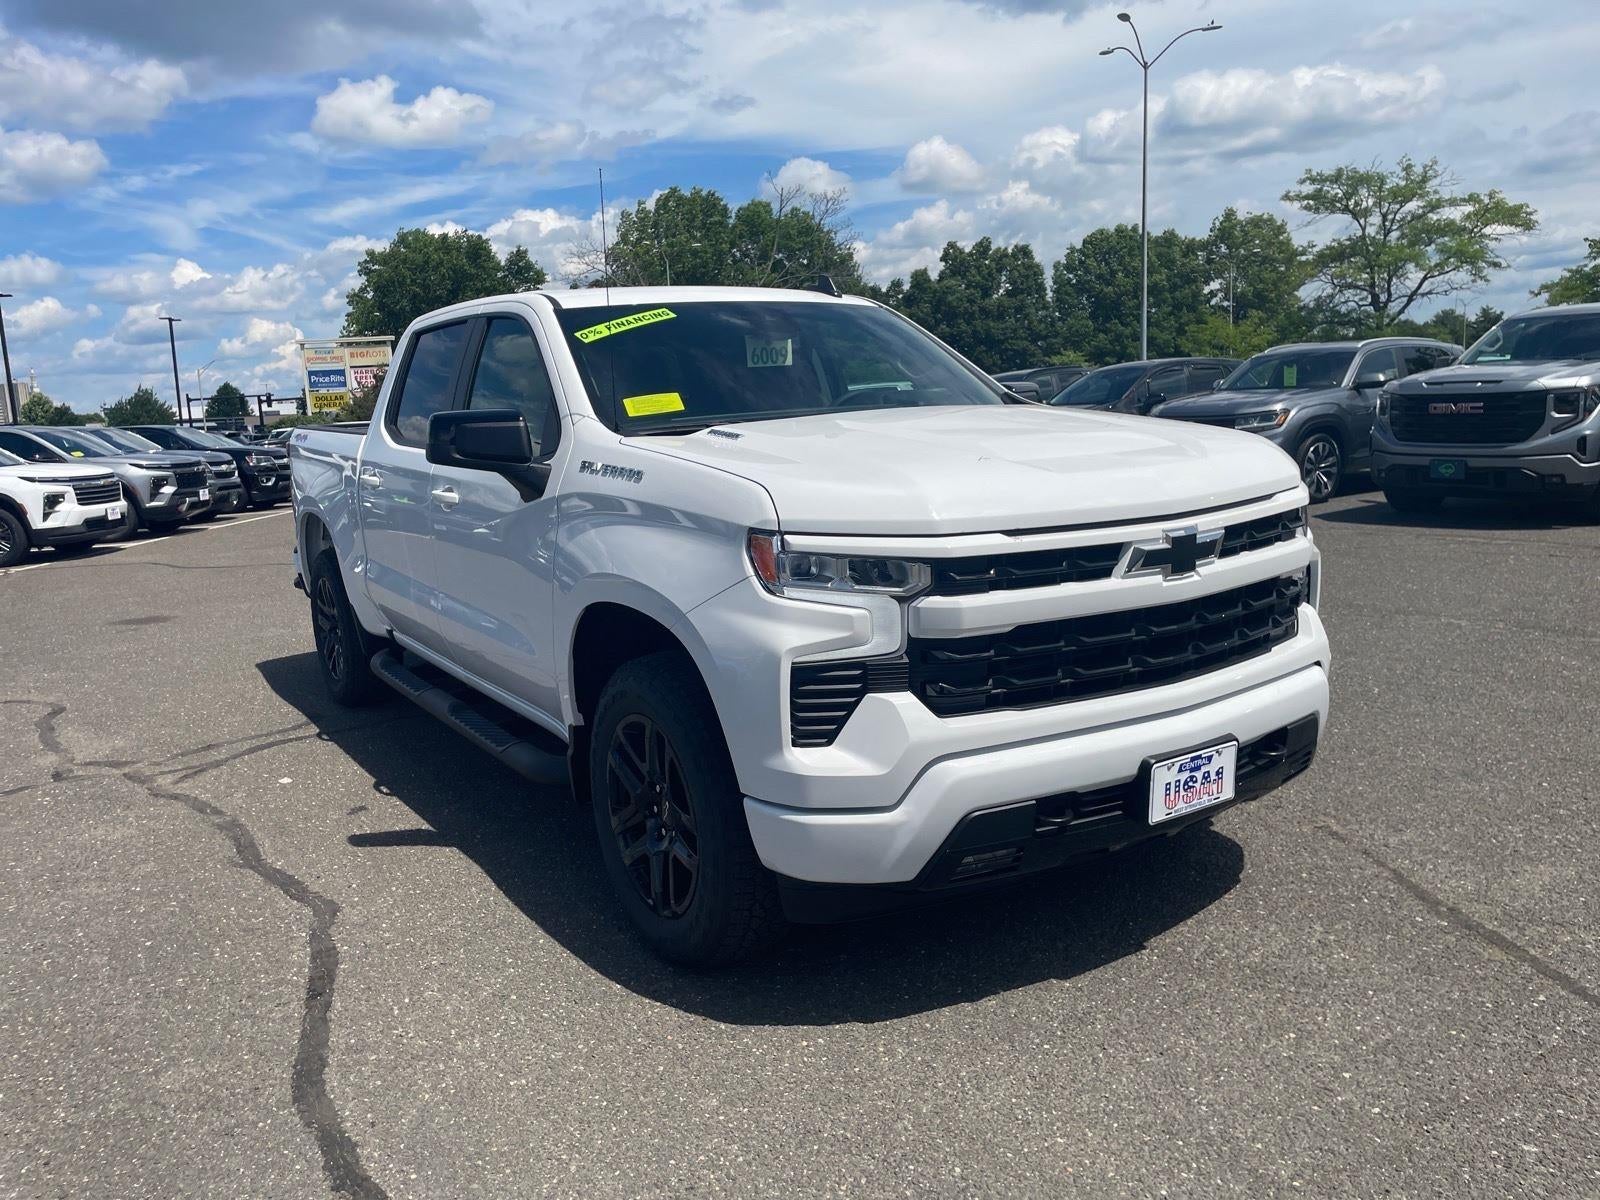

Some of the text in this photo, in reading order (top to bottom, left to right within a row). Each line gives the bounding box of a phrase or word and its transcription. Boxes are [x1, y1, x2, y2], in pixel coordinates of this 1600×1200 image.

[580, 310, 670, 340] 0% FINANCING
[751, 346, 787, 365] 6009
[1428, 402, 1484, 415] GMC
[579, 460, 643, 484] SILVERADO
[1181, 758, 1210, 771] CENTRAL
